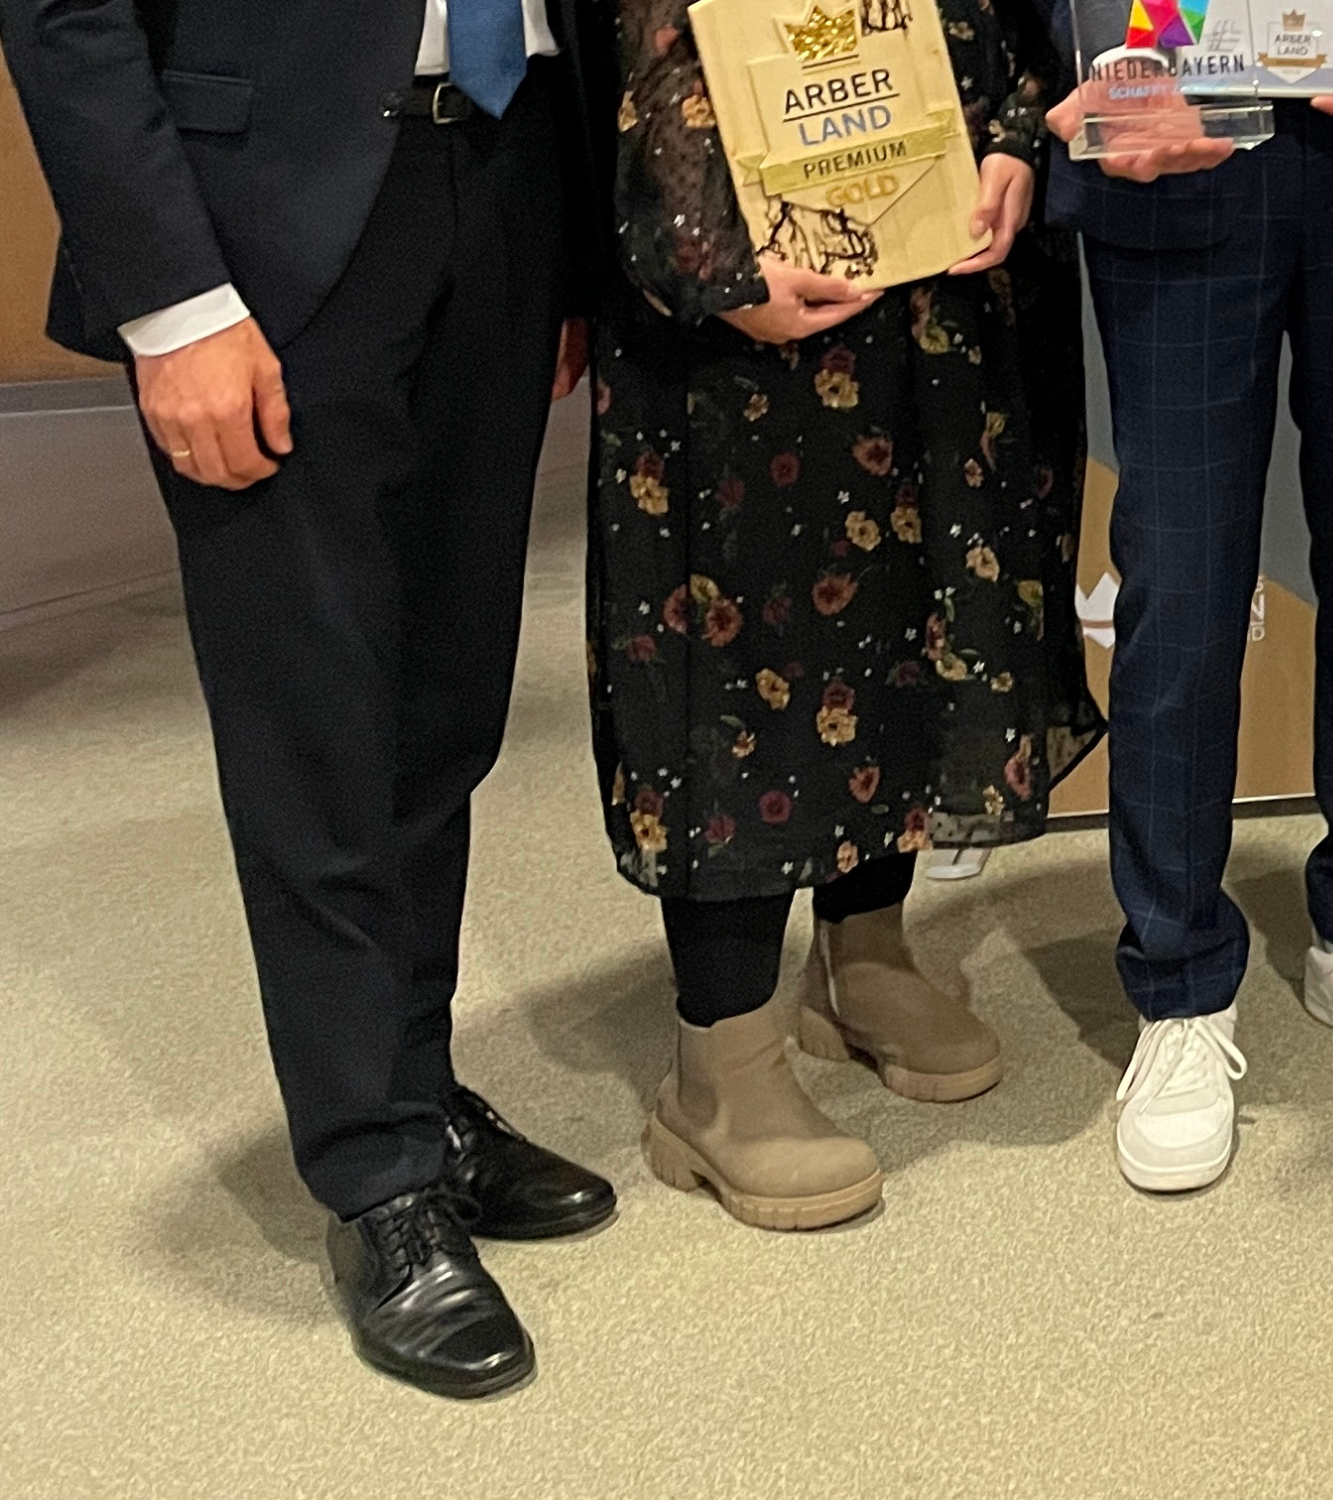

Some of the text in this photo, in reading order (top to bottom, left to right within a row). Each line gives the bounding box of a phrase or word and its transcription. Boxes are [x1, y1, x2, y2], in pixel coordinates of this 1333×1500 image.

[1091, 54, 1245, 82] NIEDERBAYERN
[784, 67, 894, 116] ARBER
[799, 104, 892, 147] LAND
[803, 140, 908, 179] PREMIUM
[825, 173, 900, 208] GOLD
